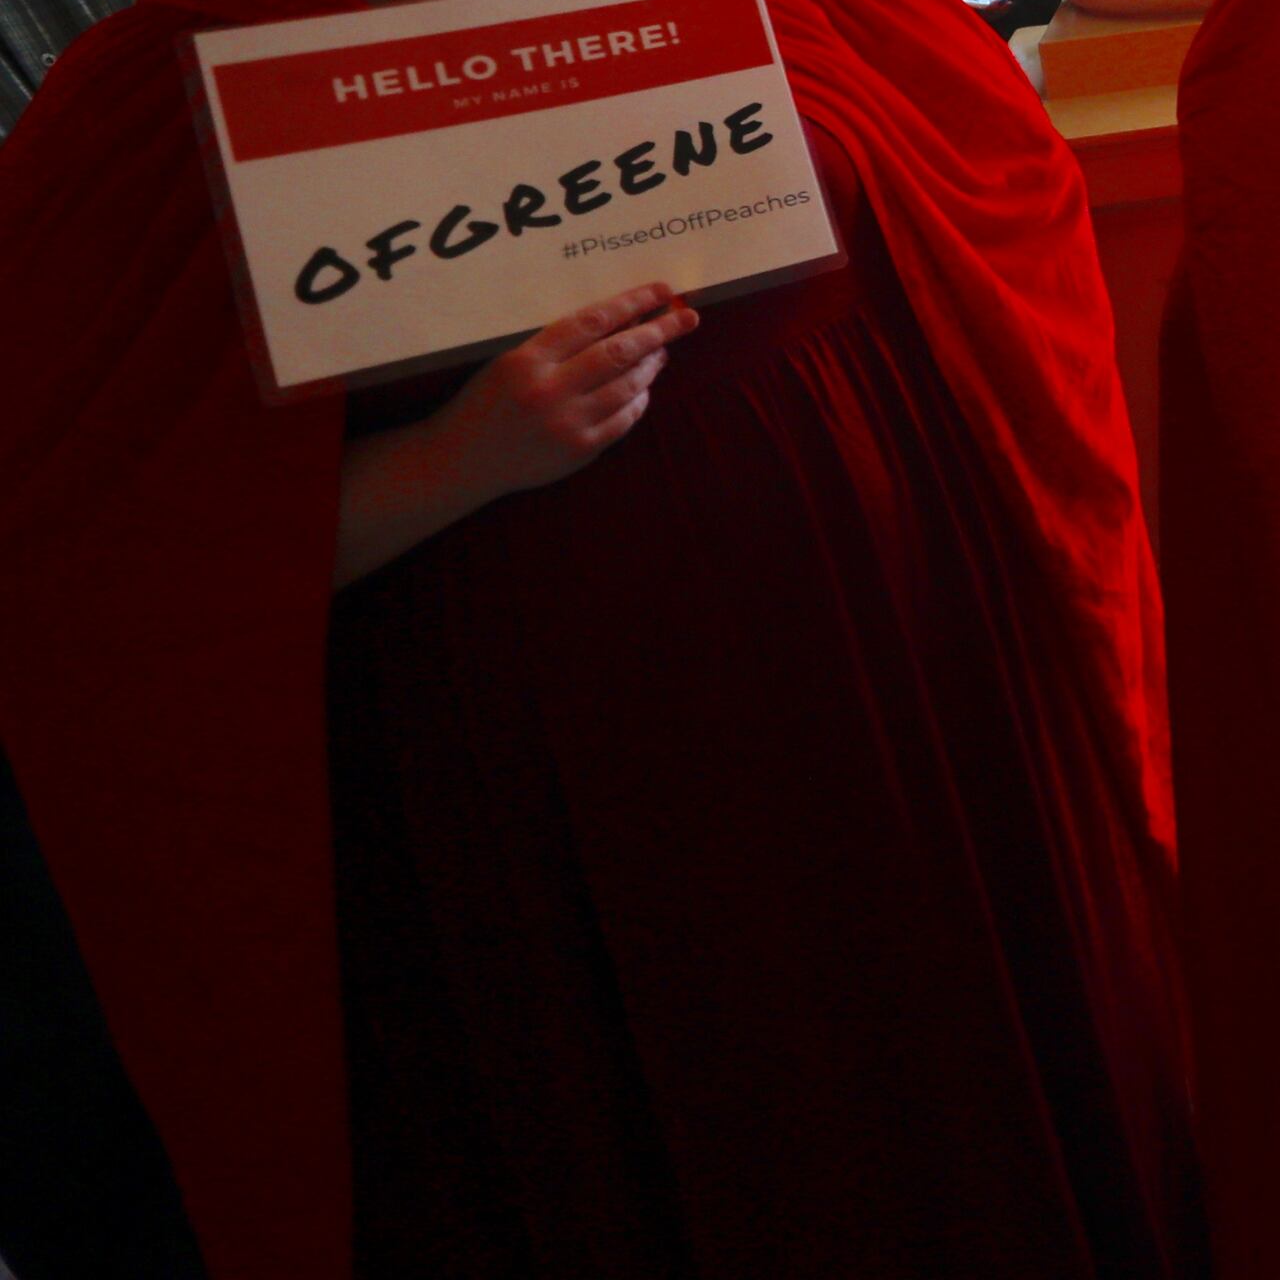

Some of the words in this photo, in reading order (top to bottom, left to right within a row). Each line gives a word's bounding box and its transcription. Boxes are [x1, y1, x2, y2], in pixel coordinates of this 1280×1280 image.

[332, 53, 499, 104] HELLO
[511, 22, 681, 74] THERE!
[453, 93, 483, 111] MY
[491, 81, 553, 104] NAME
[560, 76, 582, 91] IS
[293, 101, 774, 306] OFGREENE
[561, 188, 811, 261] #PissedOffPeaches
